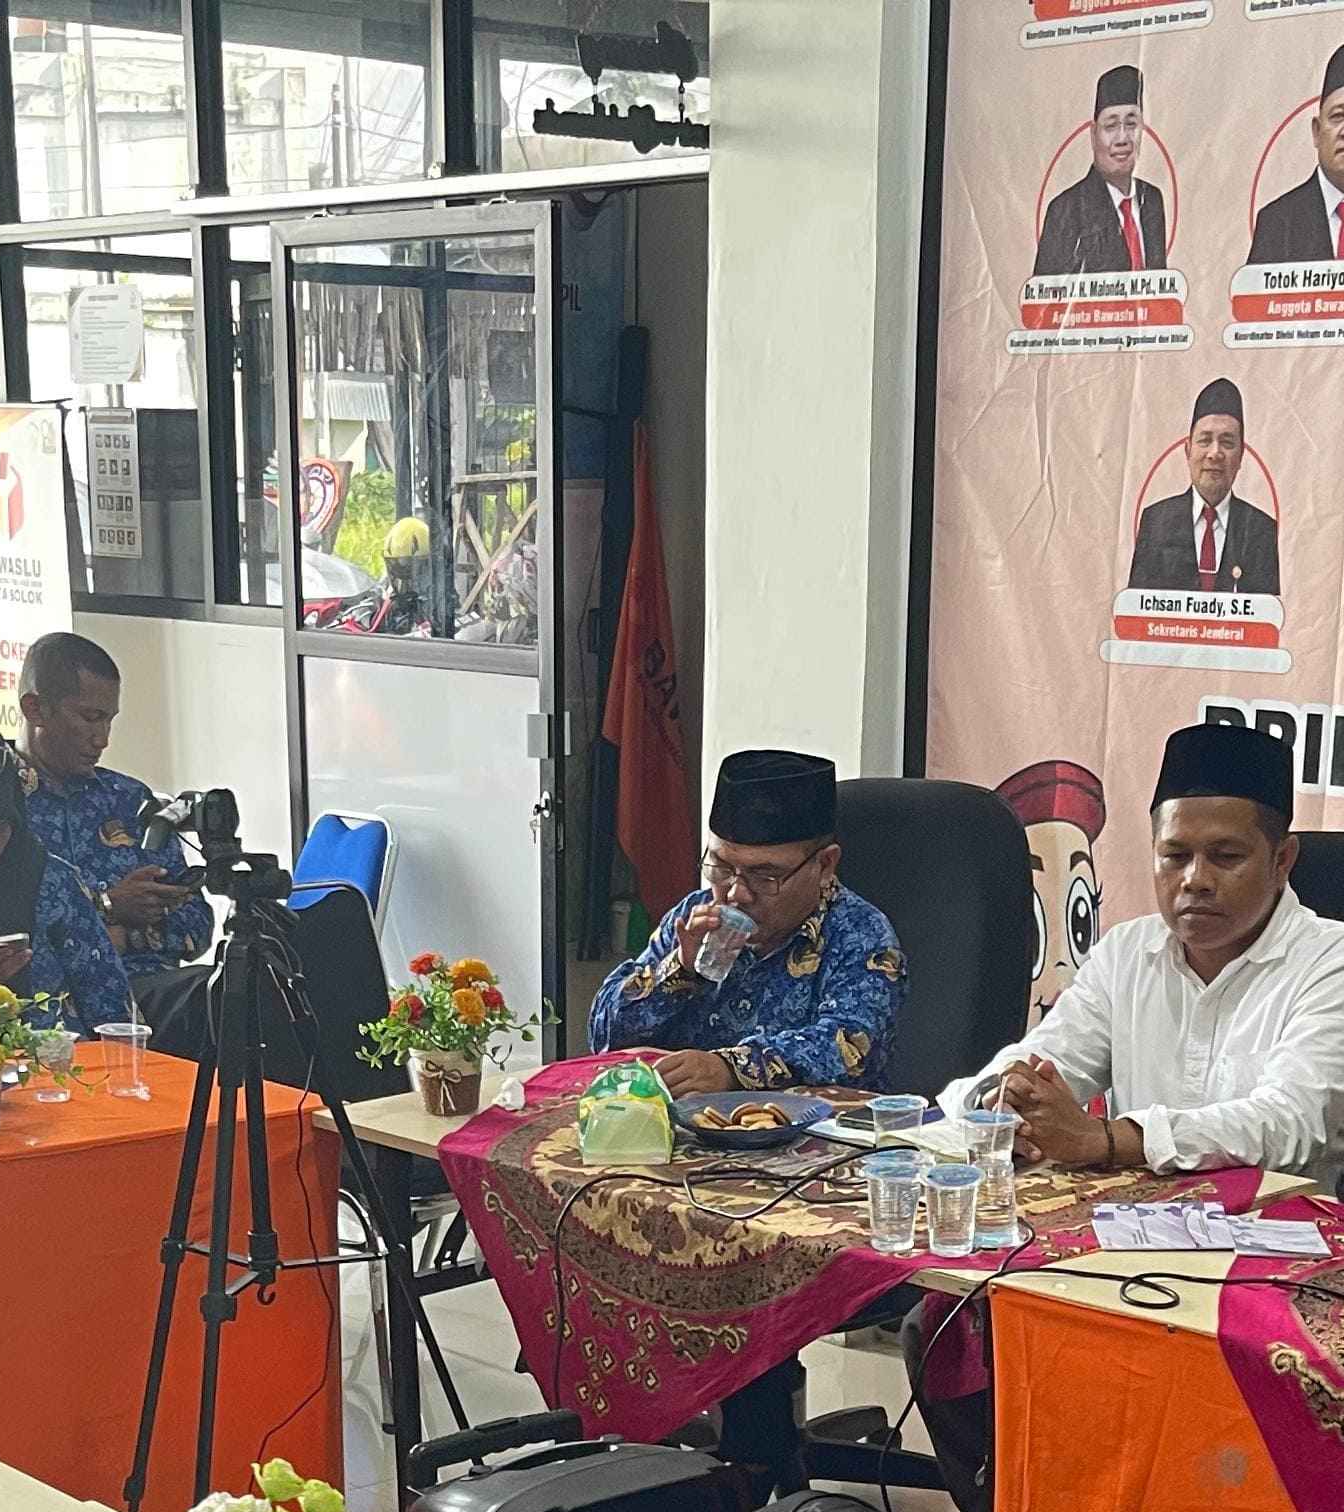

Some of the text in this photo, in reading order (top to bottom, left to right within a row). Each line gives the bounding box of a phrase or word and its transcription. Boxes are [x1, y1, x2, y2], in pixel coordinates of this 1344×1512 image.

[1264, 271, 1298, 289] Totok
[1053, 311, 1091, 325] Anggota
[1094, 309, 1134, 322] Bawaslu
[1268, 301, 1311, 317] Anggota
[9, 589, 42, 604] SOLOK
[1140, 595, 1254, 617] Ichsan Fuady, S.E.
[1147, 623, 1244, 640] Sekretaris Jenderal
